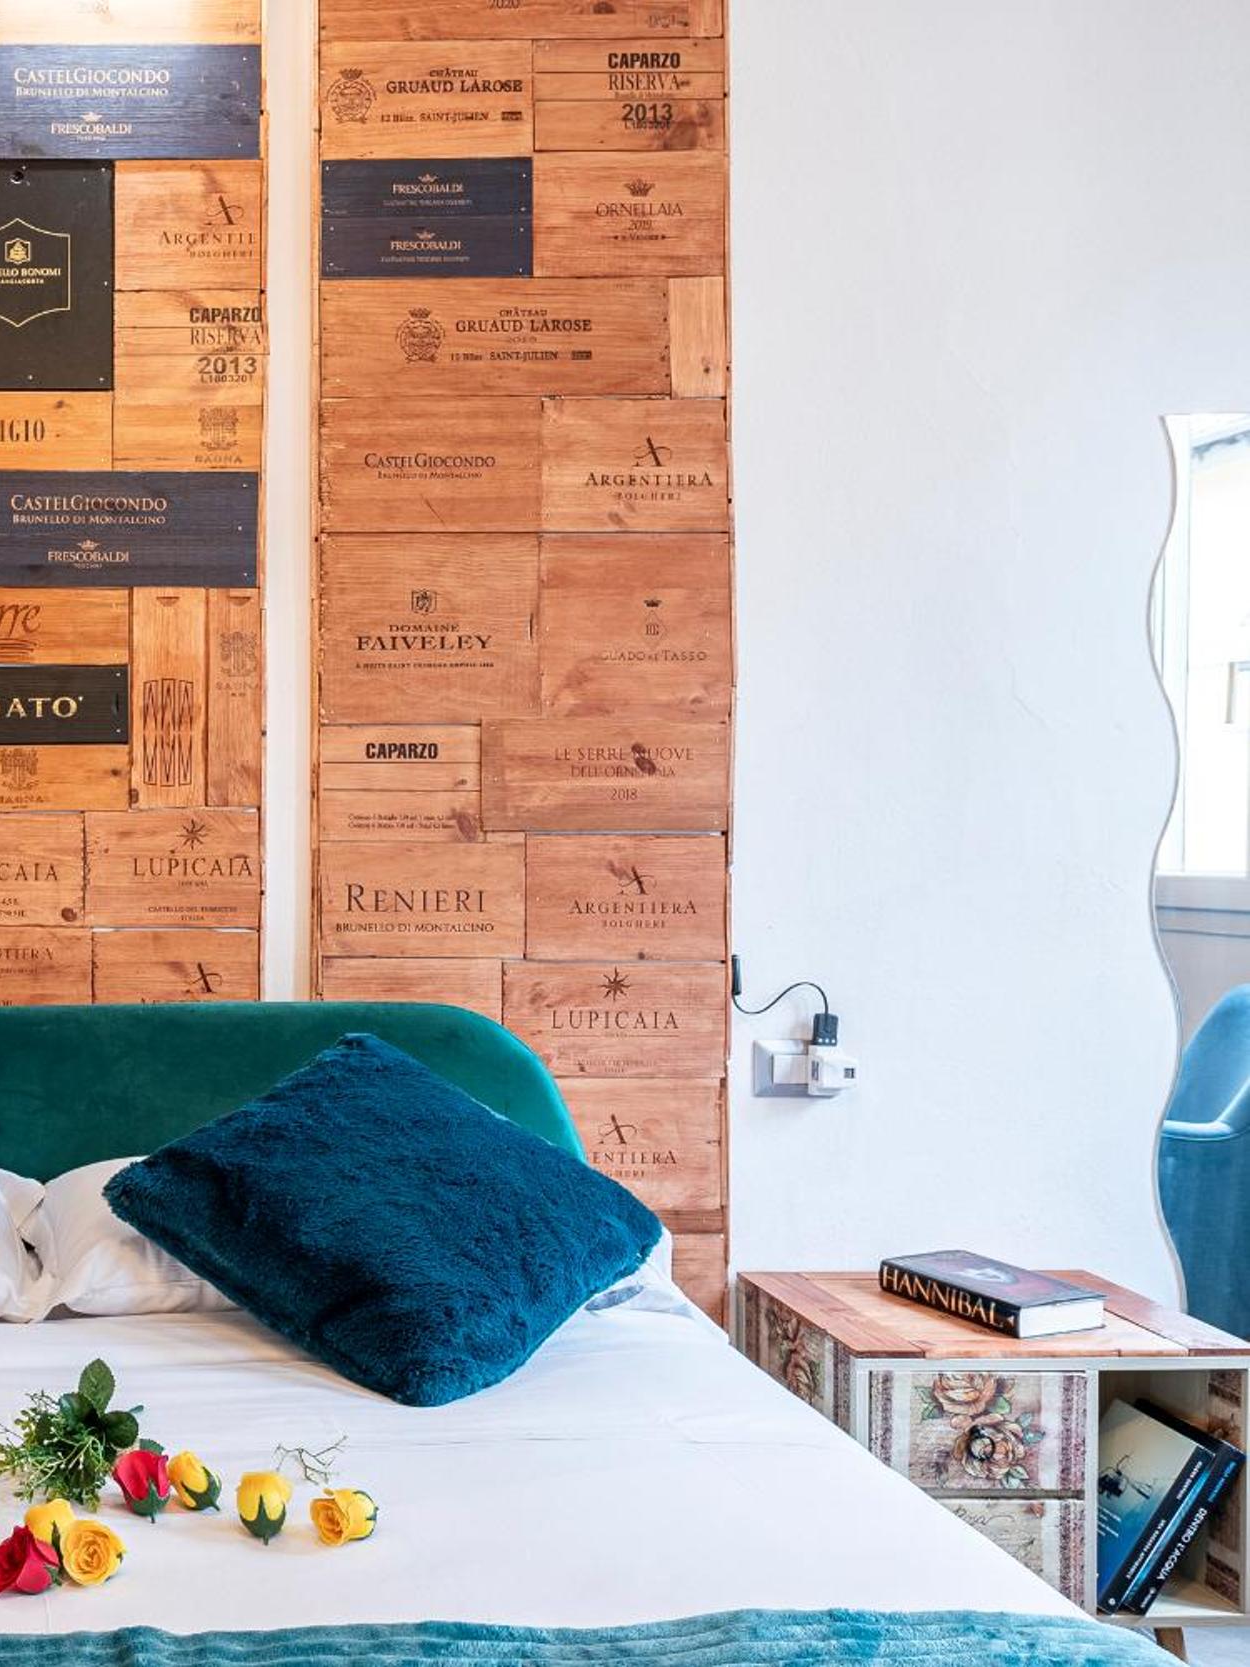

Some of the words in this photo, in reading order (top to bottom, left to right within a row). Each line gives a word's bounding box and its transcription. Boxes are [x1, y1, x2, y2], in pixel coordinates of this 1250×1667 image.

[607, 53, 681, 69] CAPARZO
[386, 80, 455, 94] GRUAUD
[459, 79, 524, 94] LAROSE
[608, 75, 681, 91] RISERVA
[15, 87, 73, 98] BRUNELLO
[76, 87, 89, 97] DI
[621, 103, 673, 122] 2013
[51, 123, 133, 135] FRESCOBALDI
[392, 183, 465, 194] FRESCOBALDI
[595, 202, 683, 217] ORNELLAIA
[390, 241, 461, 251] FRESCOBALDI
[21, 267, 61, 278] BONOMI
[189, 307, 262, 323] CAPARZO
[455, 319, 524, 333] GRUAUD
[529, 319, 592, 333] LAROSE
[190, 328, 261, 346] RISERVA
[489, 350, 559, 363] SAINT-JULIEN
[197, 357, 257, 375] 2013
[585, 472, 713, 487] ARGENTIERA
[13, 515, 70, 525] BRUNELLO
[73, 515, 86, 525] DI
[89, 514, 166, 525] MONTALCINO
[48, 551, 129, 563] FRESCOBALDI
[389, 624, 460, 633] DOMAINE
[356, 635, 493, 651] FAIVELEY
[661, 649, 708, 662] TASSO
[365, 742, 438, 760] CAPARZO
[554, 748, 572, 761] LE
[577, 748, 627, 761] SERRE
[610, 789, 638, 801] 2018
[133, 857, 253, 877] LUPICAIA
[345, 884, 485, 914] RENIERI
[568, 899, 698, 915] ARGENTIERA
[336, 923, 395, 933] BRUNELLO
[397, 923, 412, 933] DI
[414, 922, 494, 933] MONTALCINO
[551, 1010, 680, 1030] LUPICAIA
[588, 1150, 677, 1165] ENTIERA
[881, 1265, 1005, 1329] HANNIBAL
[1181, 1507, 1208, 1549] DENTRO
